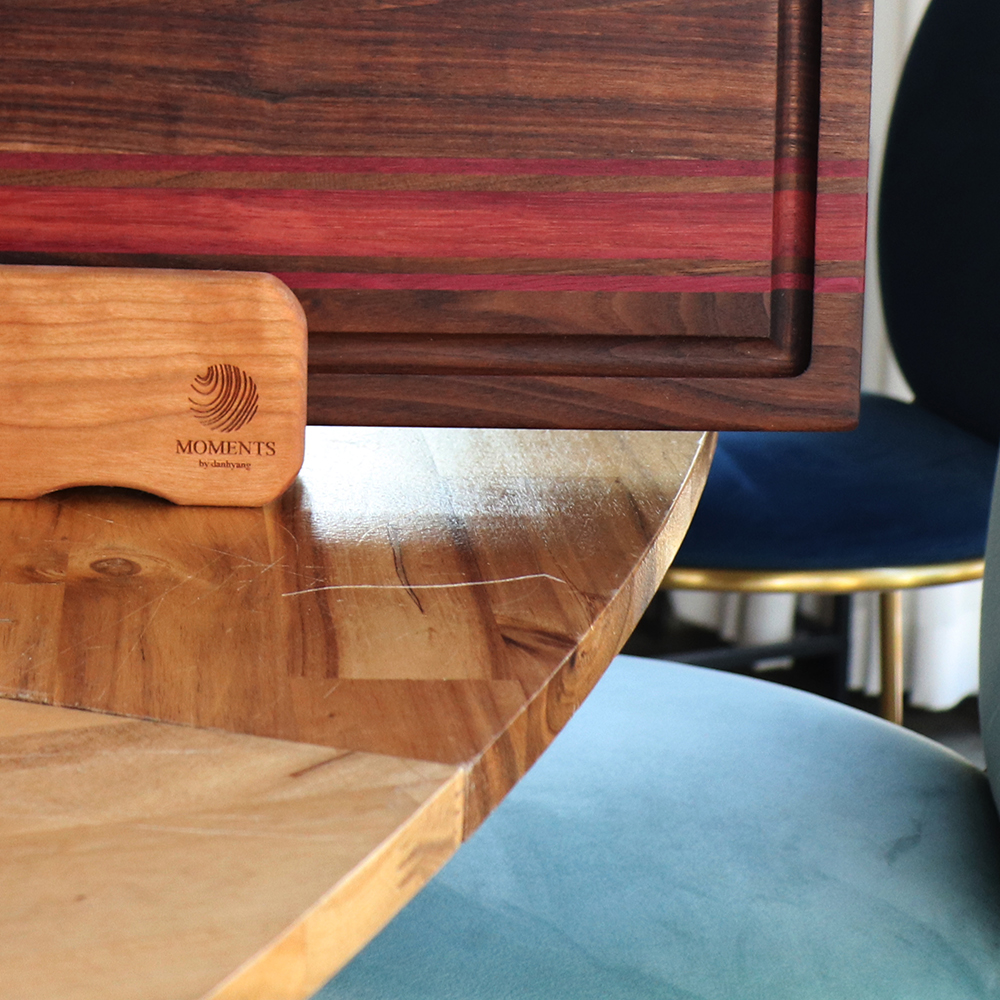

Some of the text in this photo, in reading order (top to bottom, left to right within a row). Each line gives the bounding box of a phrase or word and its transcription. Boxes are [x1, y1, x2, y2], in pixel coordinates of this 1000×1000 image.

[175, 440, 276, 456] MOMENTS
[198, 460, 251, 471] by danhyang
